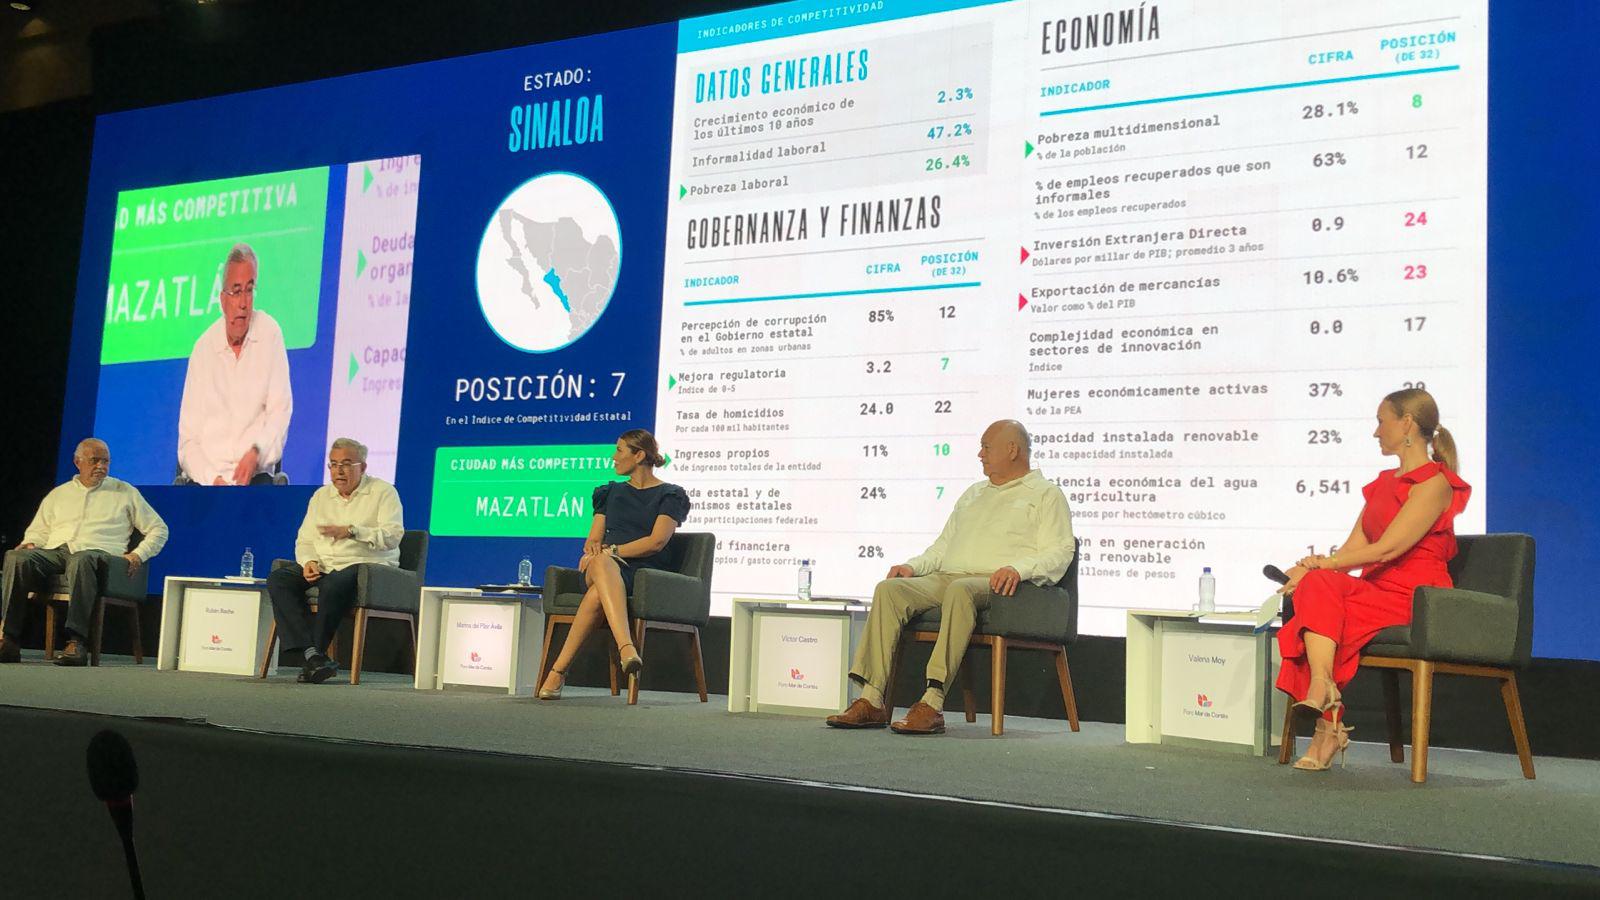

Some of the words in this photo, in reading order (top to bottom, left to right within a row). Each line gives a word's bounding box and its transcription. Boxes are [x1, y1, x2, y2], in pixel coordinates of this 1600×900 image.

[698, 19, 767, 39] INDICADORES
[771, 18, 783, 27] DE
[788, 1, 884, 24] COMPETITIVIDAD
[1042, 2, 1160, 54] ECONOMÍA
[1381, 31, 1456, 50] POSICIÓN
[1308, 51, 1354, 64] CIFRA
[1396, 52, 1415, 64] (DE
[1420, 49, 1440, 60] 32)
[524, 68, 591, 91] ESTADO:
[696, 66, 751, 103] DATOS
[761, 49, 869, 94] GENERALES
[937, 88, 973, 103] 2.3%
[1040, 79, 1110, 97] INDICADOR
[1412, 94, 1422, 108] 8
[694, 109, 768, 127] Crecimiento
[773, 102, 835, 118] económico
[840, 98, 854, 109] de
[1302, 101, 1358, 119] 28.1%
[509, 95, 603, 152] SINALOA
[694, 129, 713, 140] los
[717, 122, 763, 137] últimos
[769, 120, 782, 130] 10
[786, 116, 814, 129] años
[927, 123, 972, 139] 47.2%
[1038, 130, 1089, 145] Pobreza
[1094, 115, 1220, 139] multidimensional
[693, 148, 773, 167] Informalidad
[777, 142, 826, 157] laboral
[1313, 152, 1346, 167] 63%
[1406, 145, 1428, 159] 12
[926, 155, 970, 172] 26.4%
[1047, 179, 1061, 190] de
[1066, 175, 1119, 189] empleos
[1125, 167, 1211, 183] recuperados
[1217, 164, 1241, 176] que
[1246, 161, 1271, 171] son
[690, 182, 736, 196] Pobreza
[741, 176, 789, 190] laboral
[1036, 190, 1110, 205] informales
[687, 208, 807, 249] GOBERNANZA
[821, 206, 829, 238] Y
[840, 195, 941, 236] FINANZAS
[1312, 217, 1344, 232] 0.9
[1404, 212, 1427, 226] 24
[1034, 237, 1101, 251] Inversión
[1105, 230, 1184, 246] Extranjera
[1189, 225, 1247, 239] Directa
[921, 250, 978, 265] POSICIÓN
[866, 263, 900, 274] CIFRA
[932, 268, 948, 277] (DE
[950, 266, 966, 276] 32)
[1404, 265, 1427, 280] 23
[684, 275, 739, 288] INDICADOR
[1303, 269, 1359, 285] 10.6%
[1031, 283, 1115, 299] Exportación
[1119, 282, 1134, 292] de
[1139, 277, 1220, 291] mercancías
[868, 309, 894, 323] 85%
[939, 306, 955, 318] 12
[682, 319, 740, 333] Percepción
[746, 317, 758, 327] de
[764, 313, 826, 329] corrupción
[1311, 320, 1343, 335] 0.0
[1404, 317, 1426, 331] 17
[681, 334, 693, 343] en
[699, 331, 709, 342] el
[715, 330, 764, 341] Gobierno
[770, 327, 813, 338] estatal
[1030, 329, 1113, 345] Complejidad
[1122, 326, 1193, 339] económica
[1202, 325, 1218, 335] en
[1030, 345, 1089, 356] sectores
[1098, 344, 1112, 354] de
[1121, 340, 1201, 353] innovación
[866, 361, 891, 373] 3.2
[941, 358, 949, 370] 7
[679, 371, 714, 383] Mejora
[720, 368, 786, 382] regulatoria
[456, 369, 596, 401] POSICIÓN:
[611, 372, 626, 397] 7
[1028, 388, 1080, 401] Mujeres
[1088, 385, 1200, 398] económicamente
[1209, 384, 1268, 396] activas
[1309, 383, 1343, 397] 37%
[677, 410, 701, 420] Tasa
[706, 409, 718, 419] de
[723, 408, 784, 418] homicidios
[860, 403, 894, 415] 24.0
[935, 401, 951, 413] 22
[446, 416, 457, 425] En
[459, 415, 468, 424] el
[472, 415, 501, 424] Índice
[504, 415, 514, 423] de
[517, 413, 591, 424] Competitividad
[593, 412, 631, 421] Estatal
[1103, 432, 1174, 443] instalada
[1183, 431, 1259, 442] renovable
[1308, 430, 1342, 444] 23%
[675, 449, 721, 460] Ingresos
[727, 448, 770, 460] propios
[863, 445, 888, 457] 11%
[933, 444, 950, 456] 10
[451, 458, 496, 471] CIUDAD
[501, 455, 524, 470] MÁS
[1109, 478, 1181, 488] económica
[1190, 477, 1214, 488] del
[1224, 479, 1257, 489] agua
[1296, 480, 1350, 496] 6,541
[707, 488, 748, 498] estatal
[756, 490, 761, 500] y
[768, 488, 780, 497] de
[861, 487, 886, 499] 24%
[936, 487, 944, 499] 7
[1070, 492, 1156, 502] agricultura
[476, 492, 584, 517] MAZATLÁN
[736, 501, 792, 511] estatales
[729, 541, 789, 552] financiera
[1100, 539, 1115, 547] en
[1123, 538, 1205, 550] generación
[858, 546, 884, 559] 28%
[1100, 553, 1171, 564] renovable
